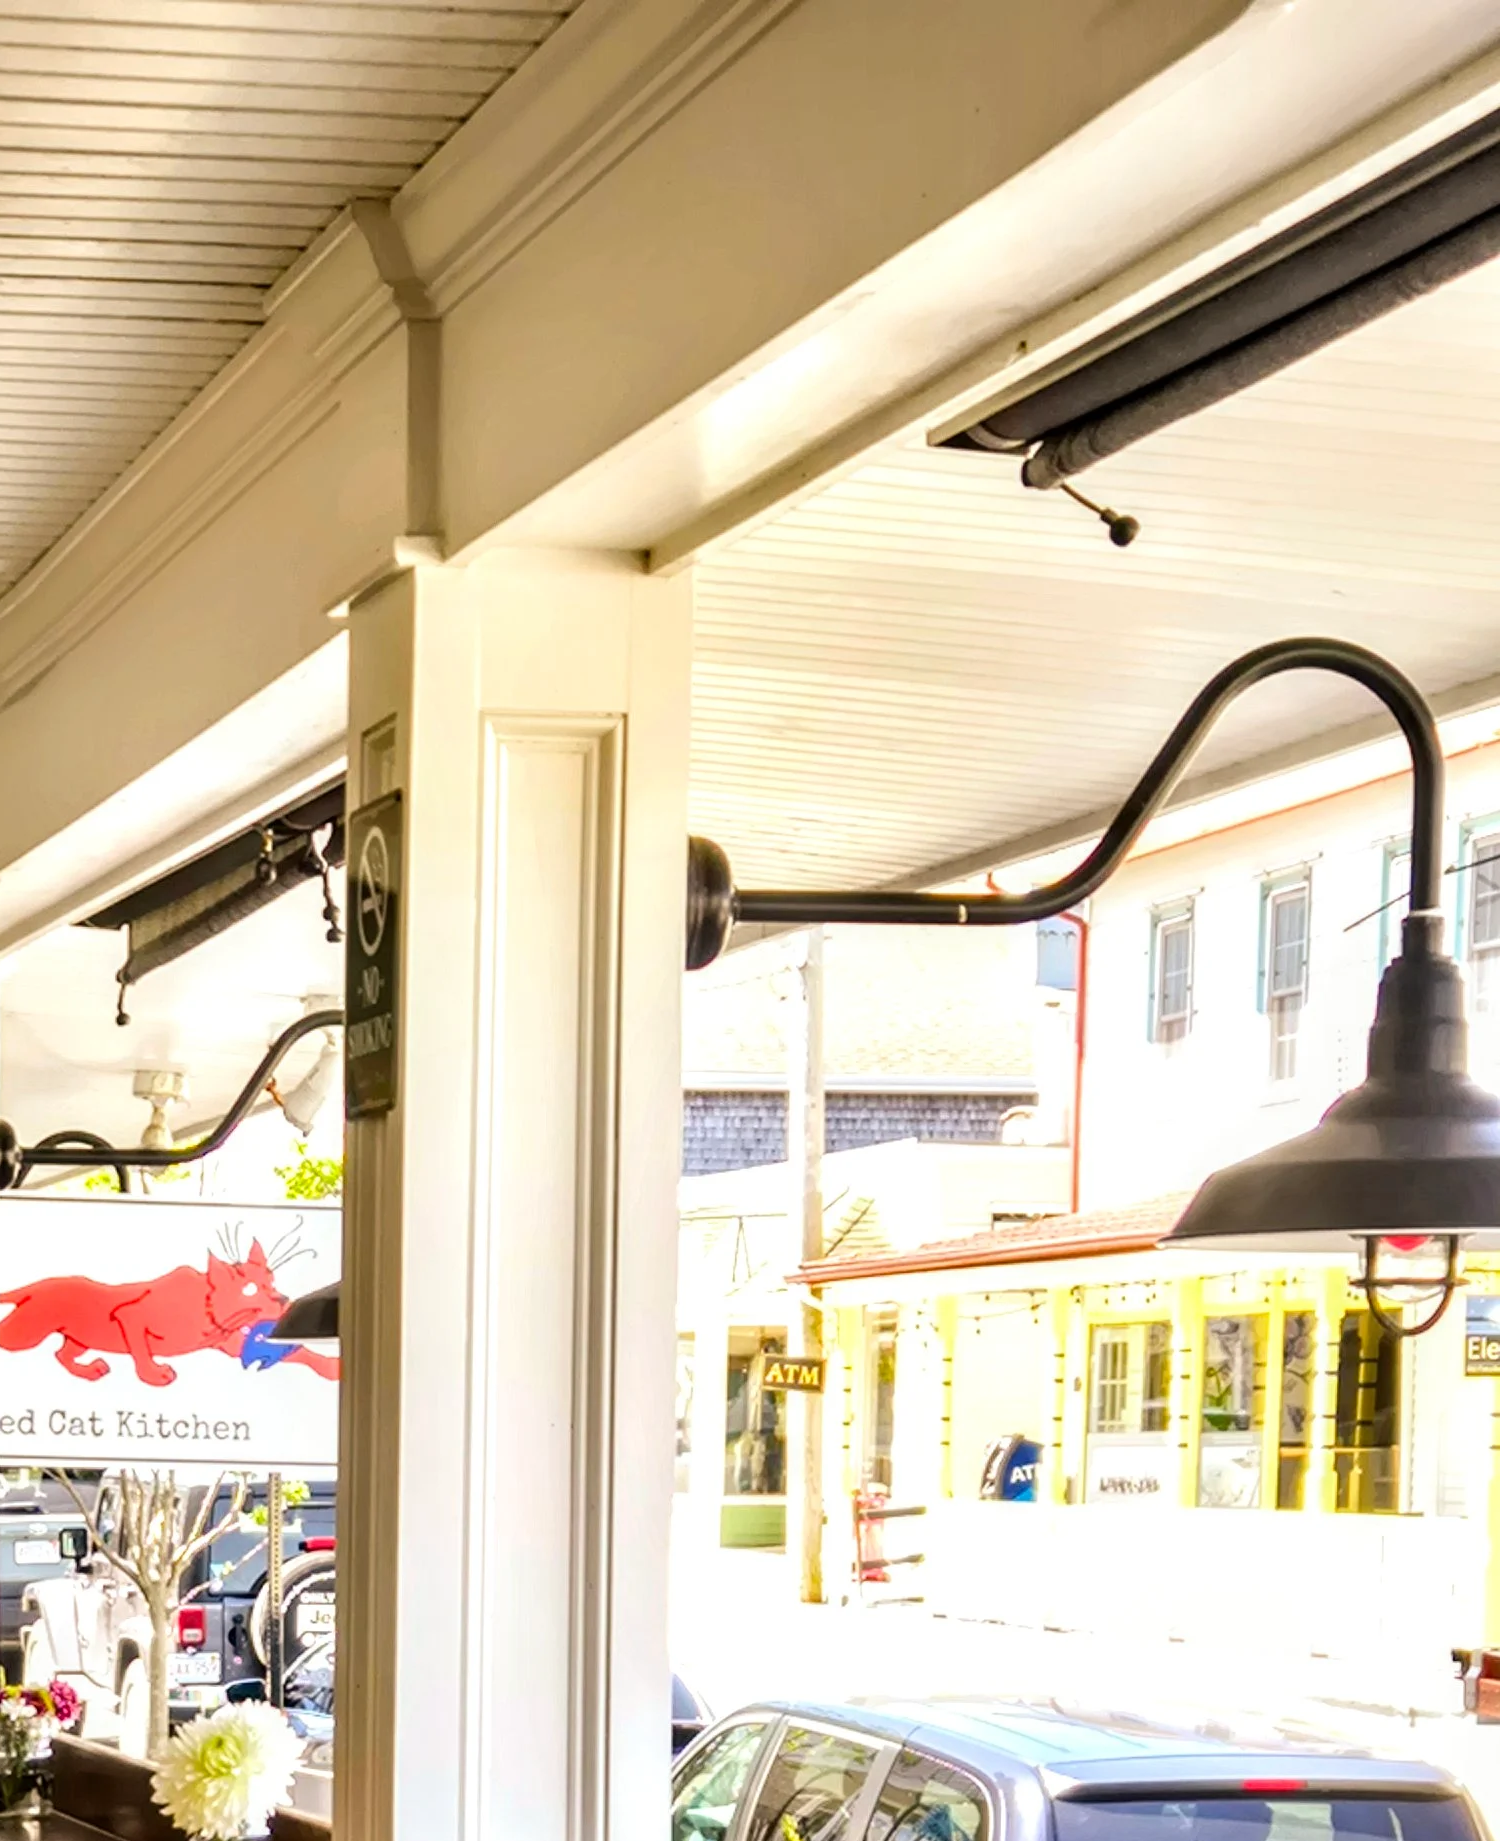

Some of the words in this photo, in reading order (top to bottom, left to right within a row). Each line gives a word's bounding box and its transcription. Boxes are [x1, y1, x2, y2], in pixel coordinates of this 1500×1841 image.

[765, 1362, 820, 1386] ATM
[48, 1408, 105, 1438] Cat
[116, 1410, 252, 1441] Kitchen
